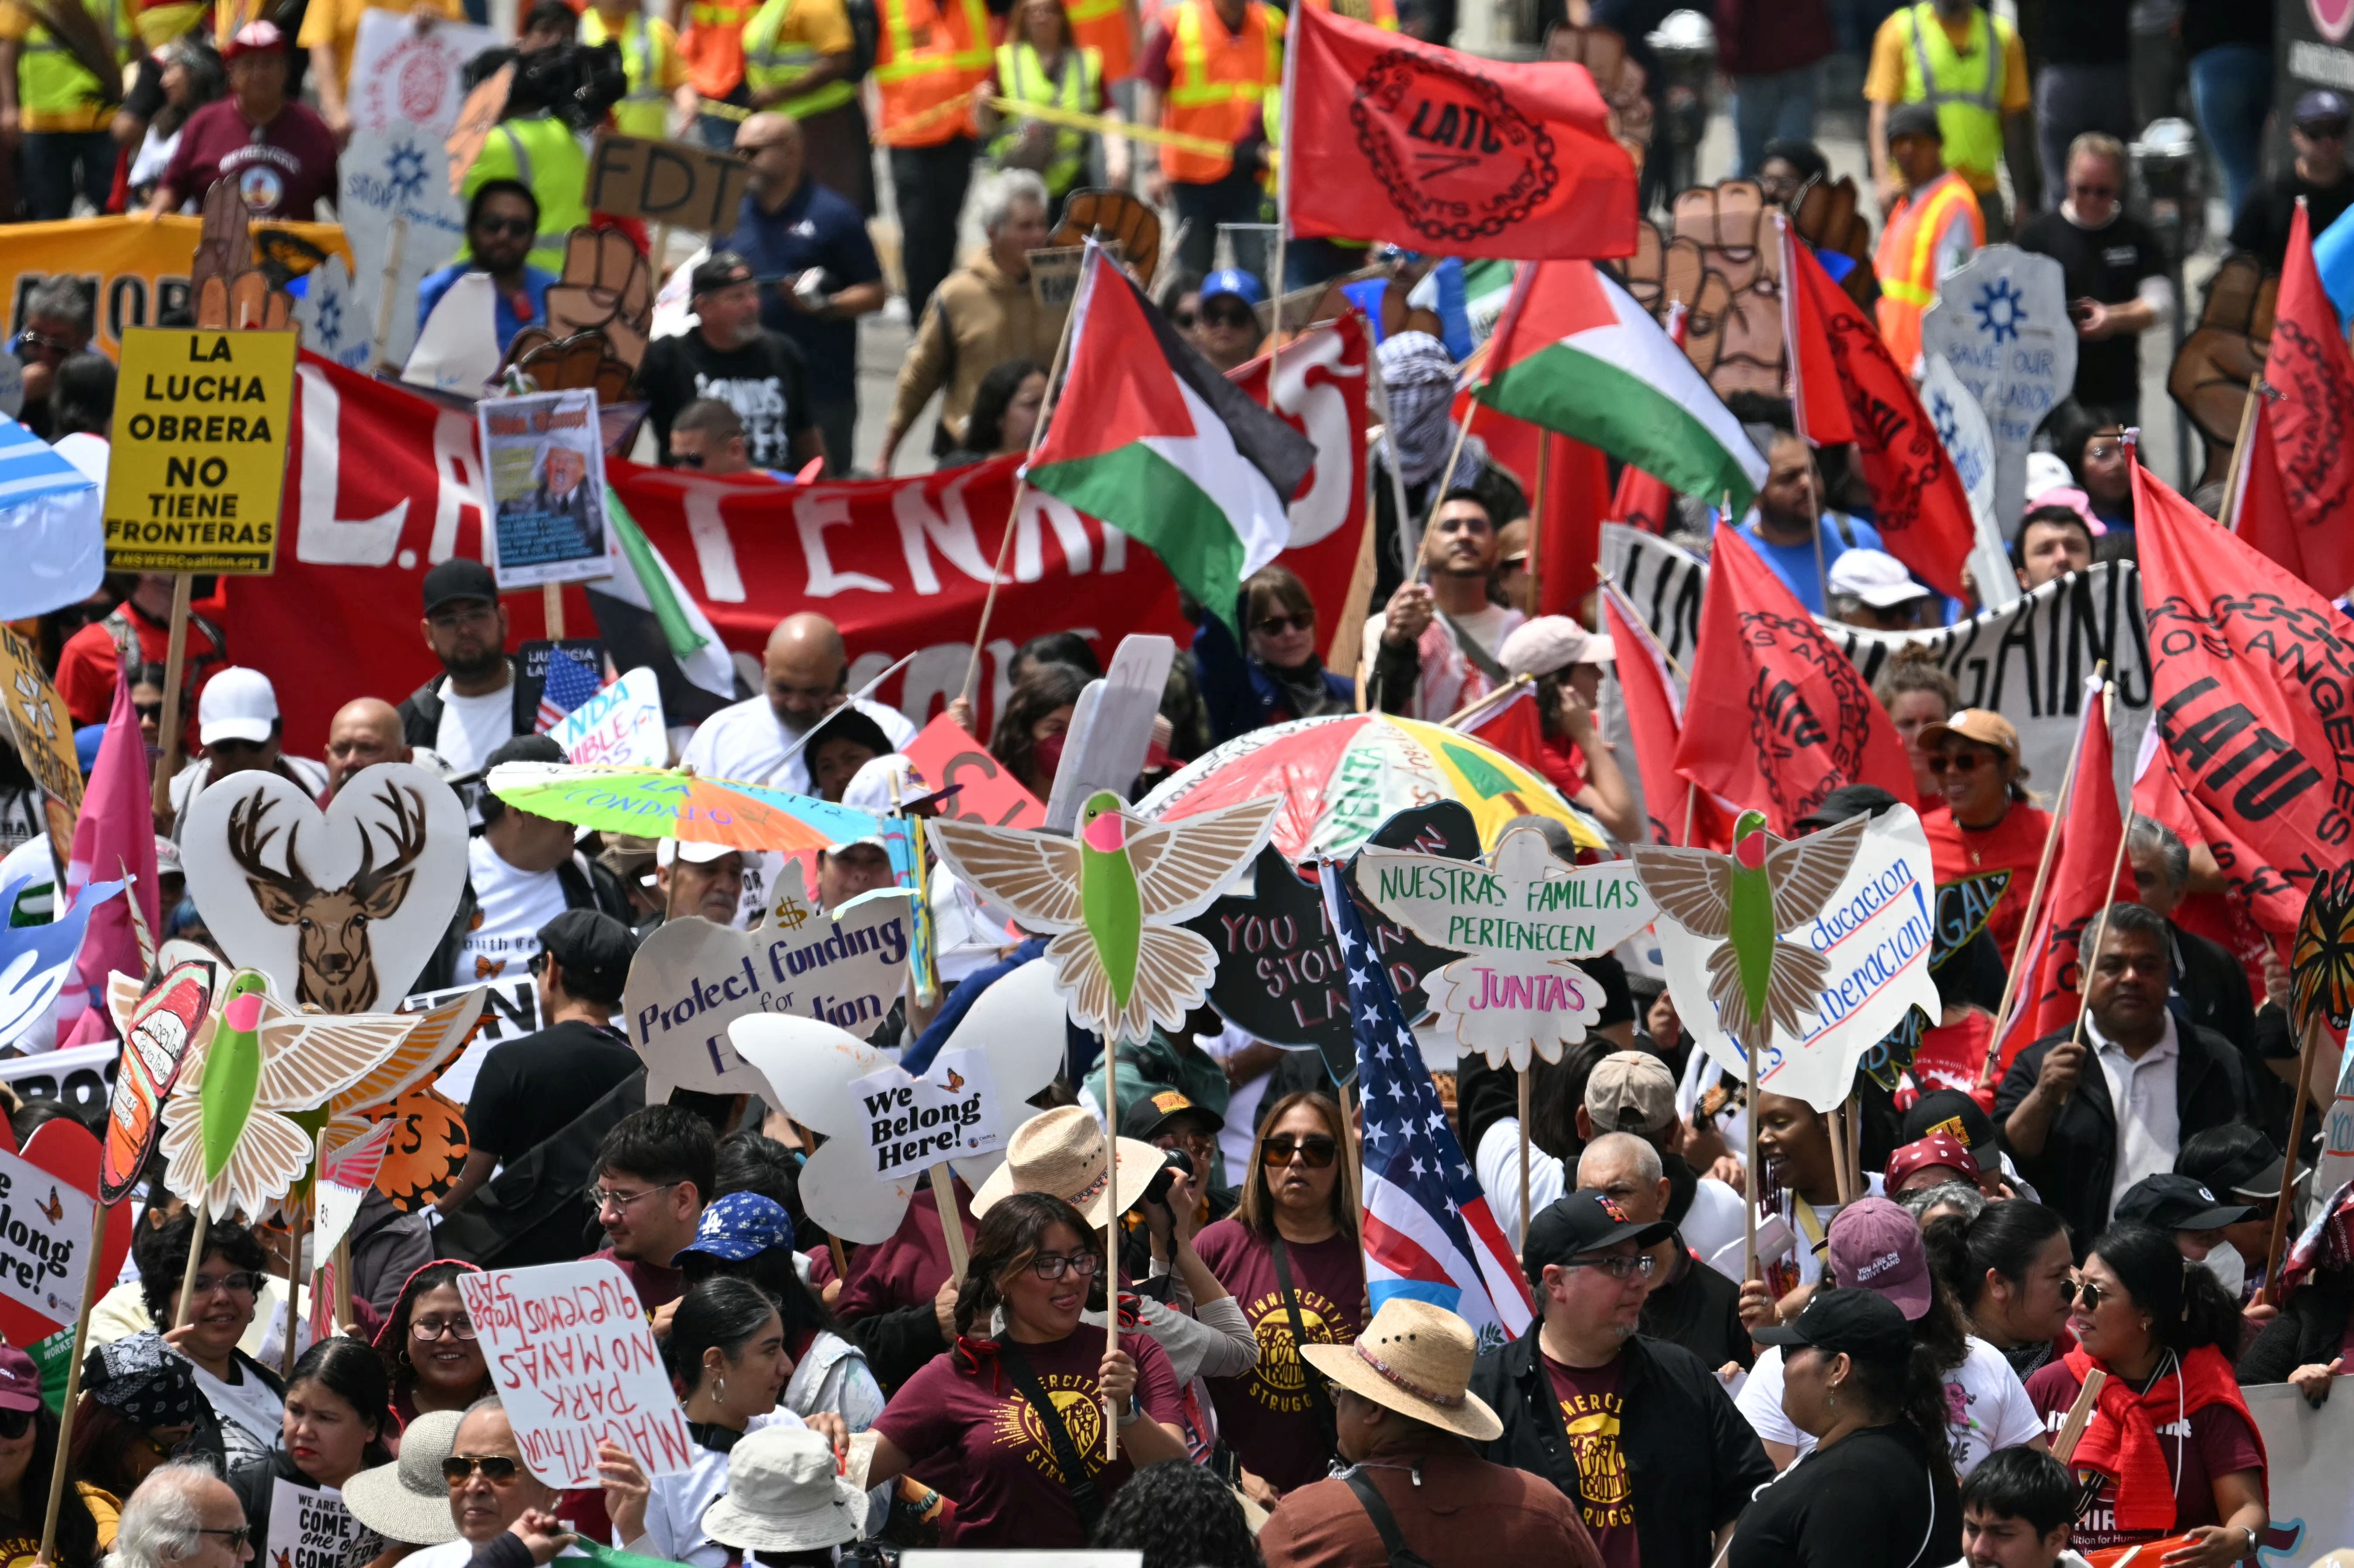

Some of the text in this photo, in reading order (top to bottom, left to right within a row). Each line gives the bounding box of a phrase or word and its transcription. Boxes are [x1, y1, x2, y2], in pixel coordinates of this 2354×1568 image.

[592, 135, 752, 225] FDT
[189, 336, 231, 362] LA
[2013, 349, 2052, 375] OUR
[145, 375, 265, 403] LUCHA
[128, 413, 272, 443] OBRERA
[166, 457, 228, 488] NO
[148, 494, 238, 518] TIENE
[105, 522, 273, 544] FRONTERAS
[2156, 675, 2323, 821] LATU
[1380, 865, 1639, 911] NUESTRAS FAMILIAS
[1810, 858, 1916, 952] ducacion
[463, 937, 508, 952] outh
[1221, 914, 1297, 953] YOU
[1448, 916, 1595, 952] PERTENECEN
[638, 956, 761, 1045] Protect
[760, 989, 795, 1013] for
[1469, 967, 1585, 1012] JUNTAS
[863, 1087, 912, 1118] We
[872, 1093, 981, 1147] Belong
[878, 1124, 963, 1172] Here!
[702, 1209, 723, 1234] LA
[1858, 1252, 1898, 1275] YOU ARE ON
[1858, 1258, 1900, 1281] NATIVE LAND
[1247, 1289, 1343, 1322] INNRCITY
[613, 1331, 655, 1375] NO
[541, 1372, 637, 1422] PARK
[298, 1493, 337, 1513] WE ARE
[299, 1509, 352, 1538] COME
[300, 1532, 335, 1550] one
